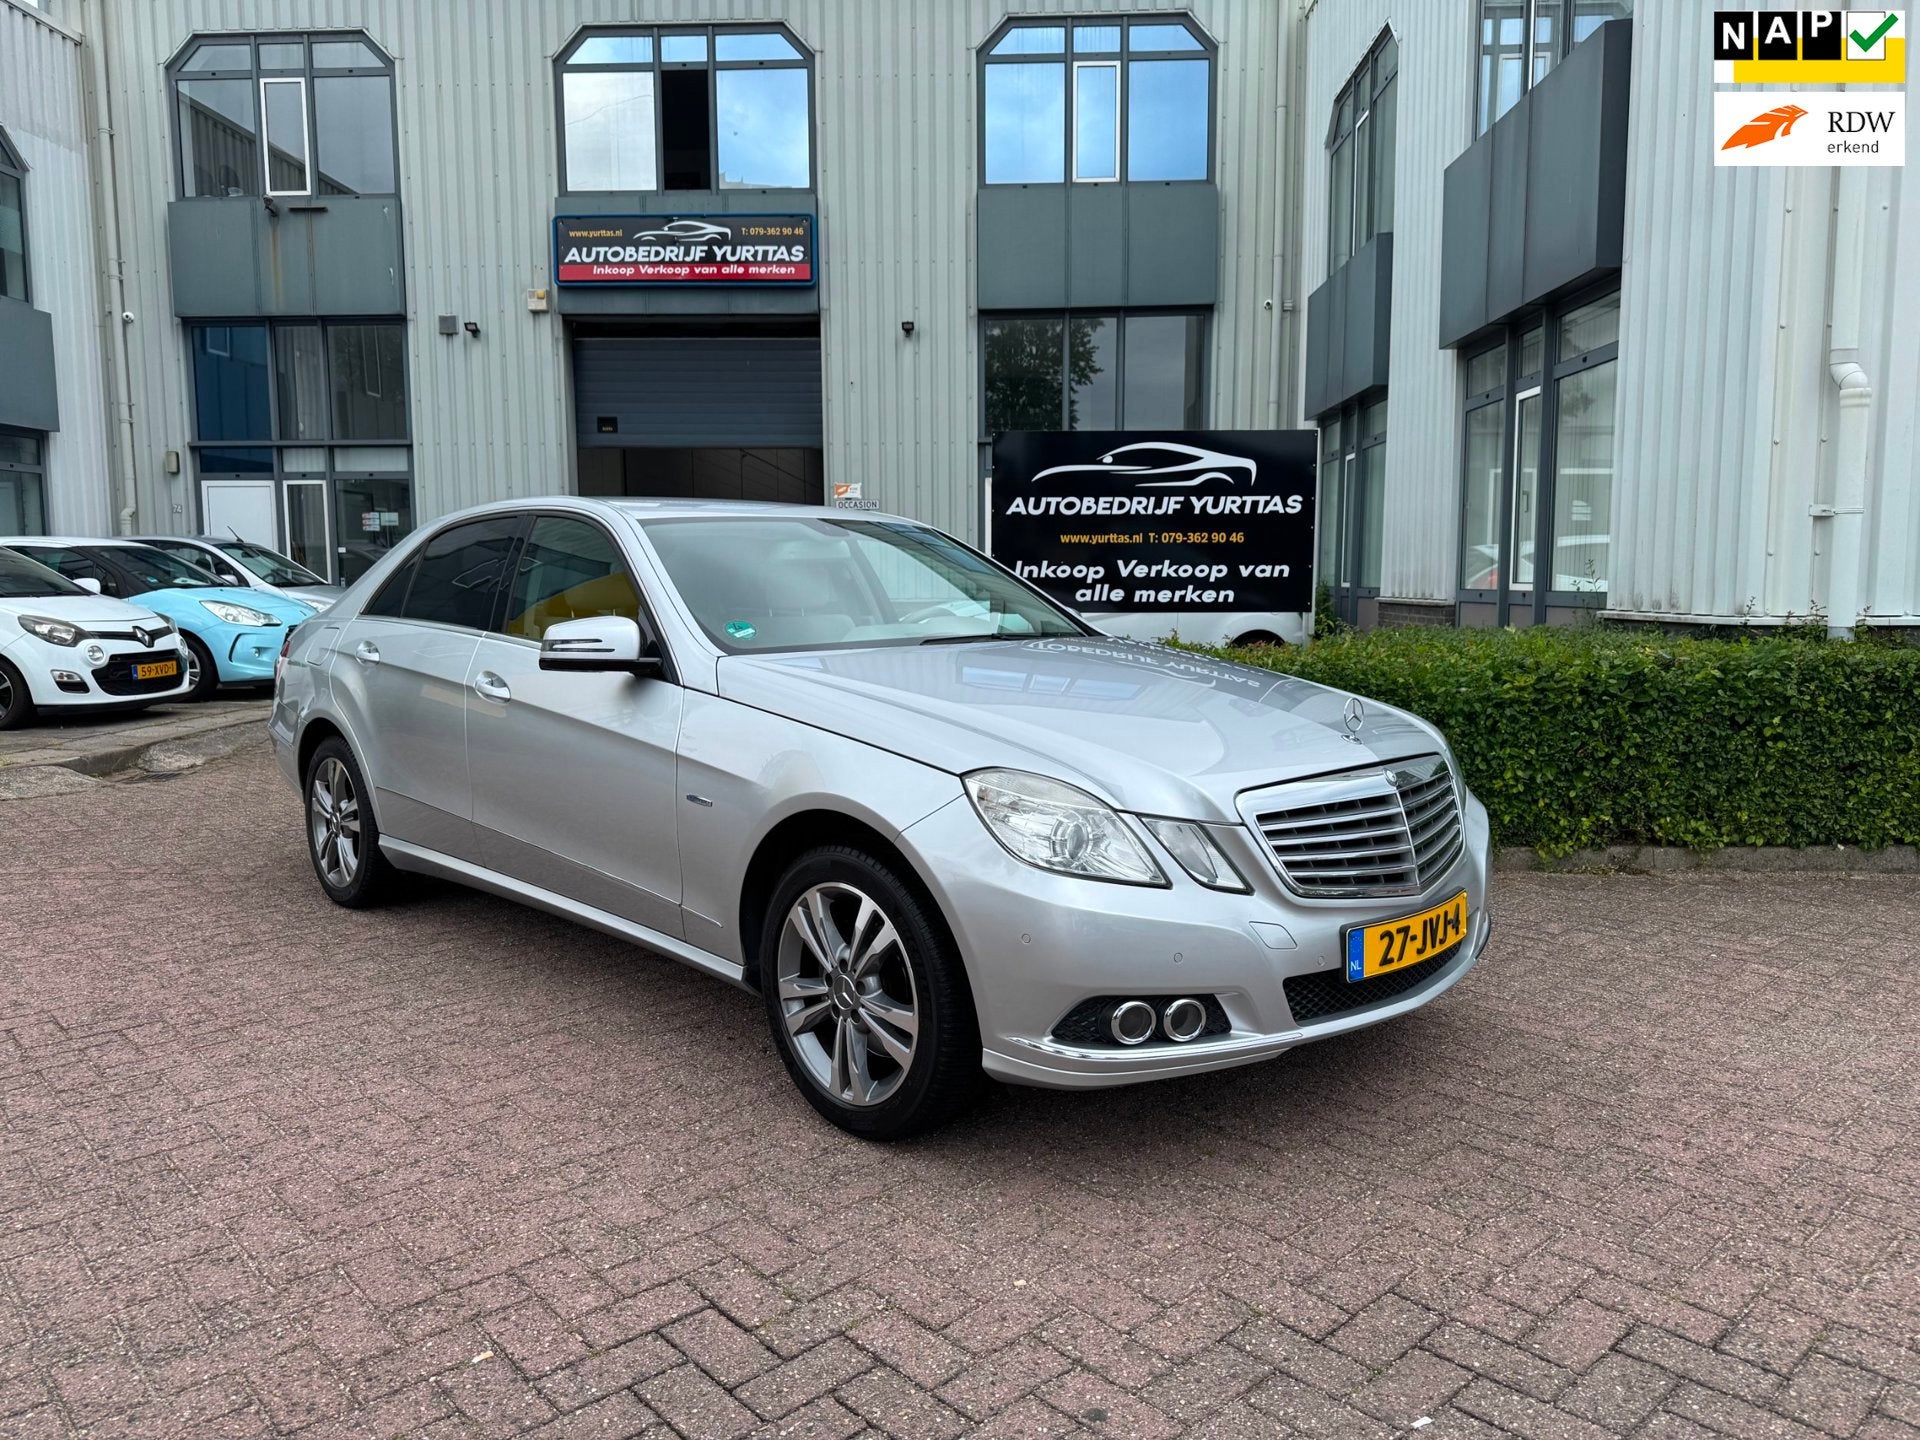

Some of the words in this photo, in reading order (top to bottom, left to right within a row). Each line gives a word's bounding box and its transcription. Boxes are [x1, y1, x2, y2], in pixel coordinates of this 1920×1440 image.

[568, 229, 623, 238] www.yurttas.nl
[741, 227, 749, 236] T:
[749, 227, 781, 236] 079-362
[782, 227, 793, 236] 90
[793, 227, 804, 236] 46
[564, 246, 708, 263] AUTOBEDRIJF
[712, 245, 805, 262] YURTTAS
[592, 265, 635, 276] Inkoop
[639, 265, 690, 276] Verkoop
[694, 266, 717, 274] van
[721, 265, 745, 274] alle
[748, 265, 796, 274] merken
[837, 501, 878, 509] OCCASION
[1005, 496, 1185, 516] AUTOBEDRIJF
[1189, 494, 1304, 515] YURTTAS
[1060, 532, 1143, 545] www.yurttas.nl
[1148, 532, 1159, 543] T:
[1161, 532, 1209, 543] 079-362
[1211, 532, 1227, 543] 90
[1229, 532, 1245, 543] 46
[1015, 560, 1105, 583] Inkoop
[1116, 559, 1228, 582] Verkoop
[1238, 564, 1290, 578] van
[1074, 584, 1125, 602] alle
[1133, 584, 1235, 603] merken
[1379, 902, 1461, 967] 27-JVJ-4
[1350, 960, 1362, 972] NL
